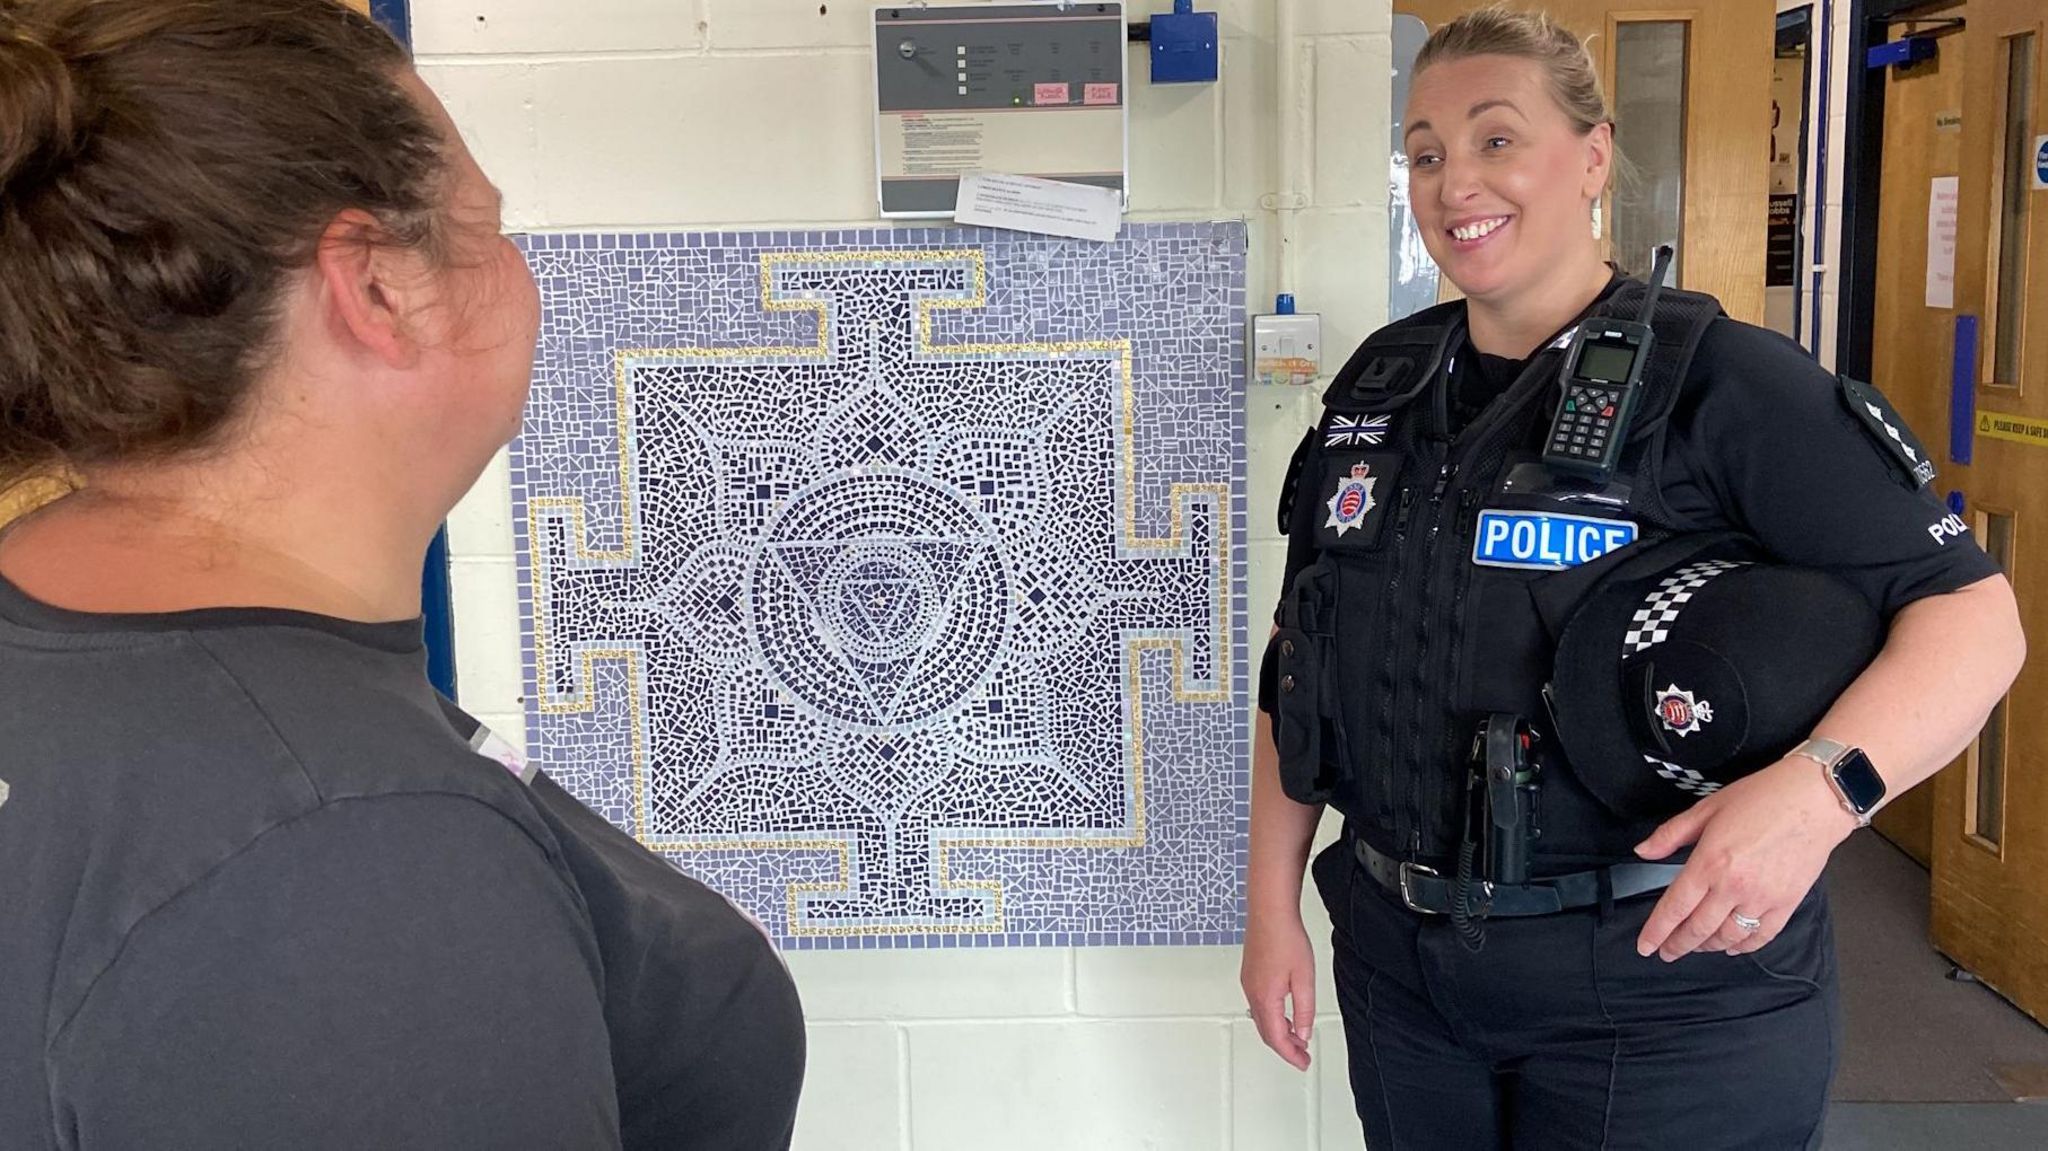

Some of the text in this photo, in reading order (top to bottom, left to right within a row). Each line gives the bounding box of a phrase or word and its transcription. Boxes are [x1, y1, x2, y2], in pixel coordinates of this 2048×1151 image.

[1769, 198, 1793, 207] ussell
[1769, 207, 1790, 215] obbs
[1484, 519, 1625, 563] POLICE
